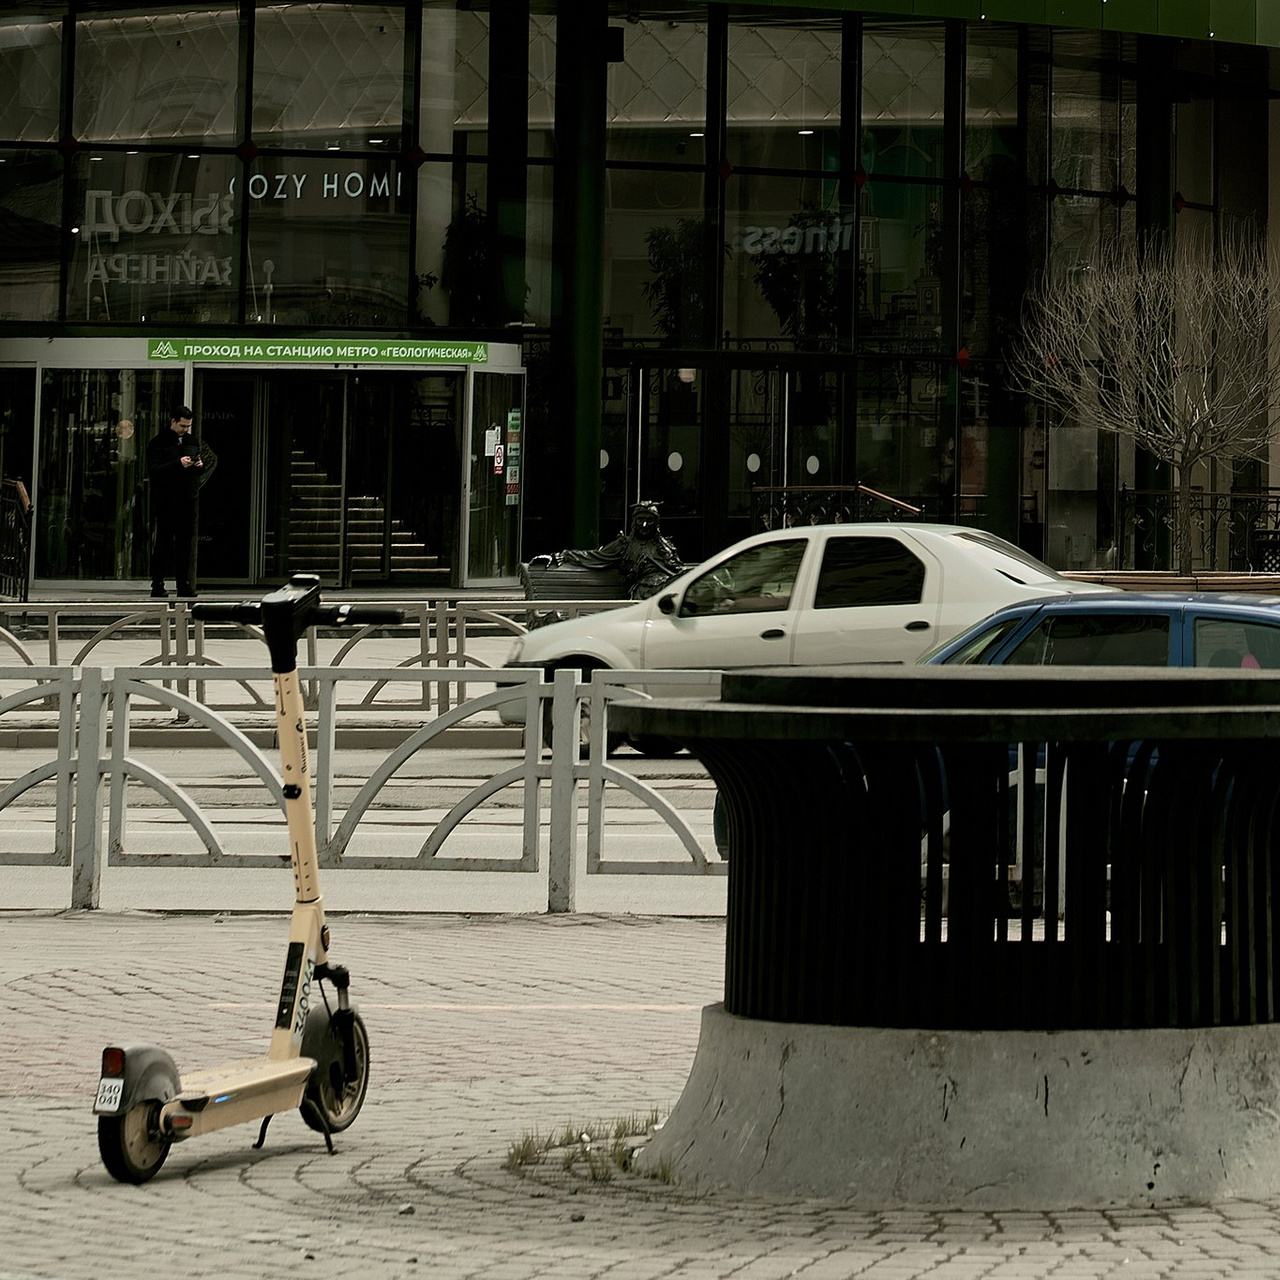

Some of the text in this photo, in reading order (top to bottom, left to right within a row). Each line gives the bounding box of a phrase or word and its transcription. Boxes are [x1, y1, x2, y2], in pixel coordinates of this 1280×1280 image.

[323, 172, 402, 198] HOM
[184, 345, 472, 359] ПРОХОД НА СТАНЦИЮ МЕТРО «ГЕОЛОГИЧЕСКАЯ»
